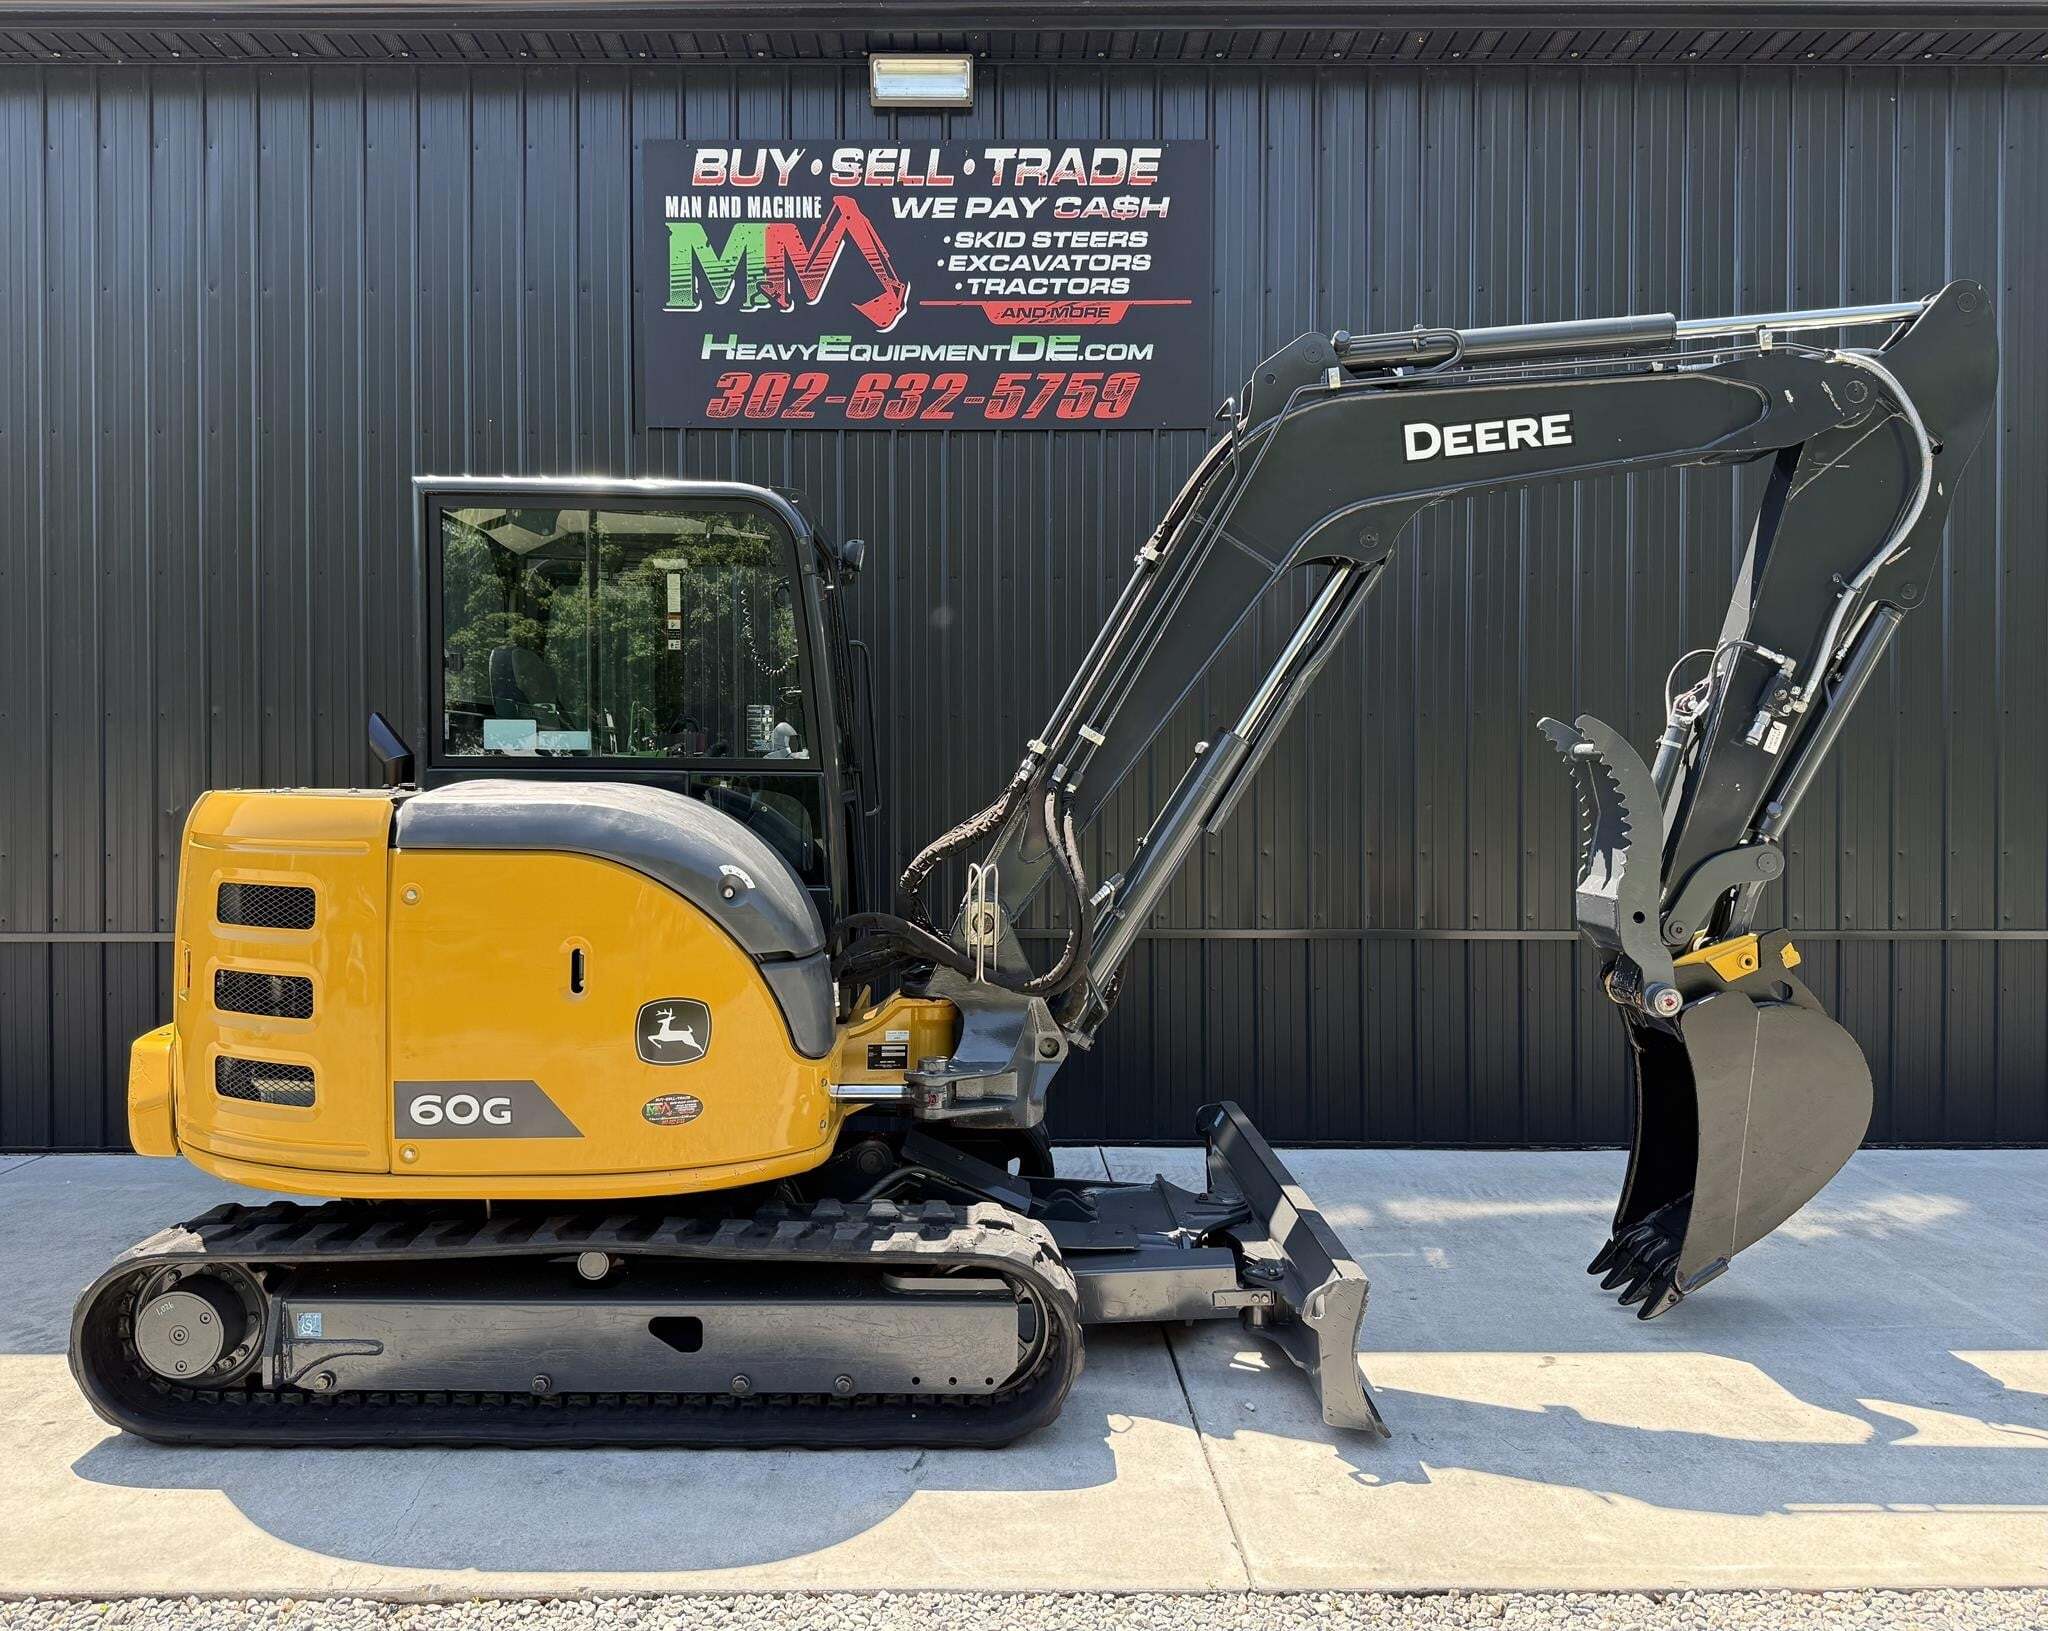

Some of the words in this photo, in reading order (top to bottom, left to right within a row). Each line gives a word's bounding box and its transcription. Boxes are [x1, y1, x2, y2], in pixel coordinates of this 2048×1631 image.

[691, 148, 806, 186] BUY
[830, 148, 955, 186] SELL
[983, 148, 1162, 186] TRADE
[665, 195, 702, 218] MAN
[708, 195, 742, 218] AND
[747, 195, 822, 218] MACHINE
[891, 197, 957, 219] WE
[964, 197, 1047, 219] PAY
[1053, 194, 1171, 221] CA$H
[954, 231, 1026, 248] SKID
[1031, 231, 1149, 248] STEERS
[948, 254, 1152, 272] EXCAVATORS
[967, 277, 1131, 295] TRACTORS
[704, 371, 1142, 420] 302-632-5759
[1404, 413, 1573, 461] DEERE
[409, 1094, 513, 1126] 60G
